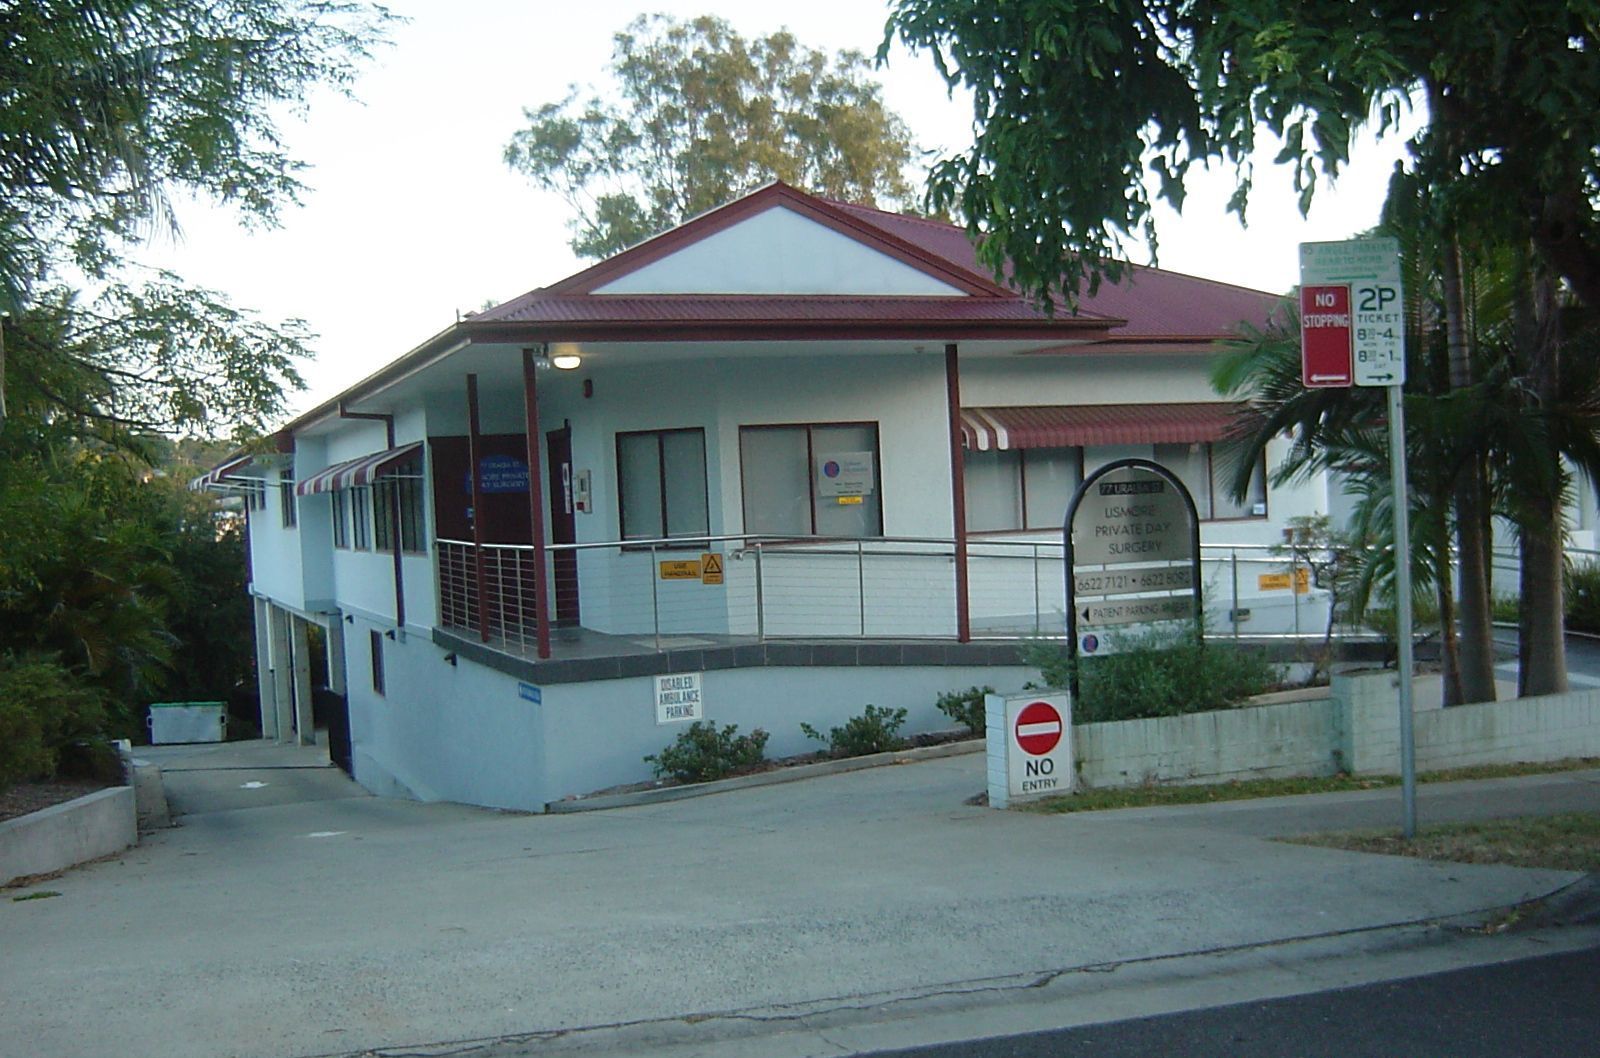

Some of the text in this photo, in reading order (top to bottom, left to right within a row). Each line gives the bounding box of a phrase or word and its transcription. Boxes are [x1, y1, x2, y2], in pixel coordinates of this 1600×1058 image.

[1315, 293, 1335, 307] NO
[1358, 287, 1396, 311] 2P
[1303, 313, 1349, 329] STOPPING
[1357, 313, 1399, 323] TICKET
[1095, 522, 1171, 537] PRIVATE DAY
[1108, 542, 1162, 555] SURGERY
[1077, 577, 1102, 591] 6622
[1104, 575, 1128, 589] 7121
[1141, 572, 1164, 586] 6622
[1092, 606, 1123, 618] PATIENT
[1126, 603, 1159, 615] PARKING
[659, 689, 700, 705] AMBULANCE
[665, 703, 695, 719] PARKING
[1026, 758, 1054, 777] NO
[1022, 778, 1058, 791] ENTRY
